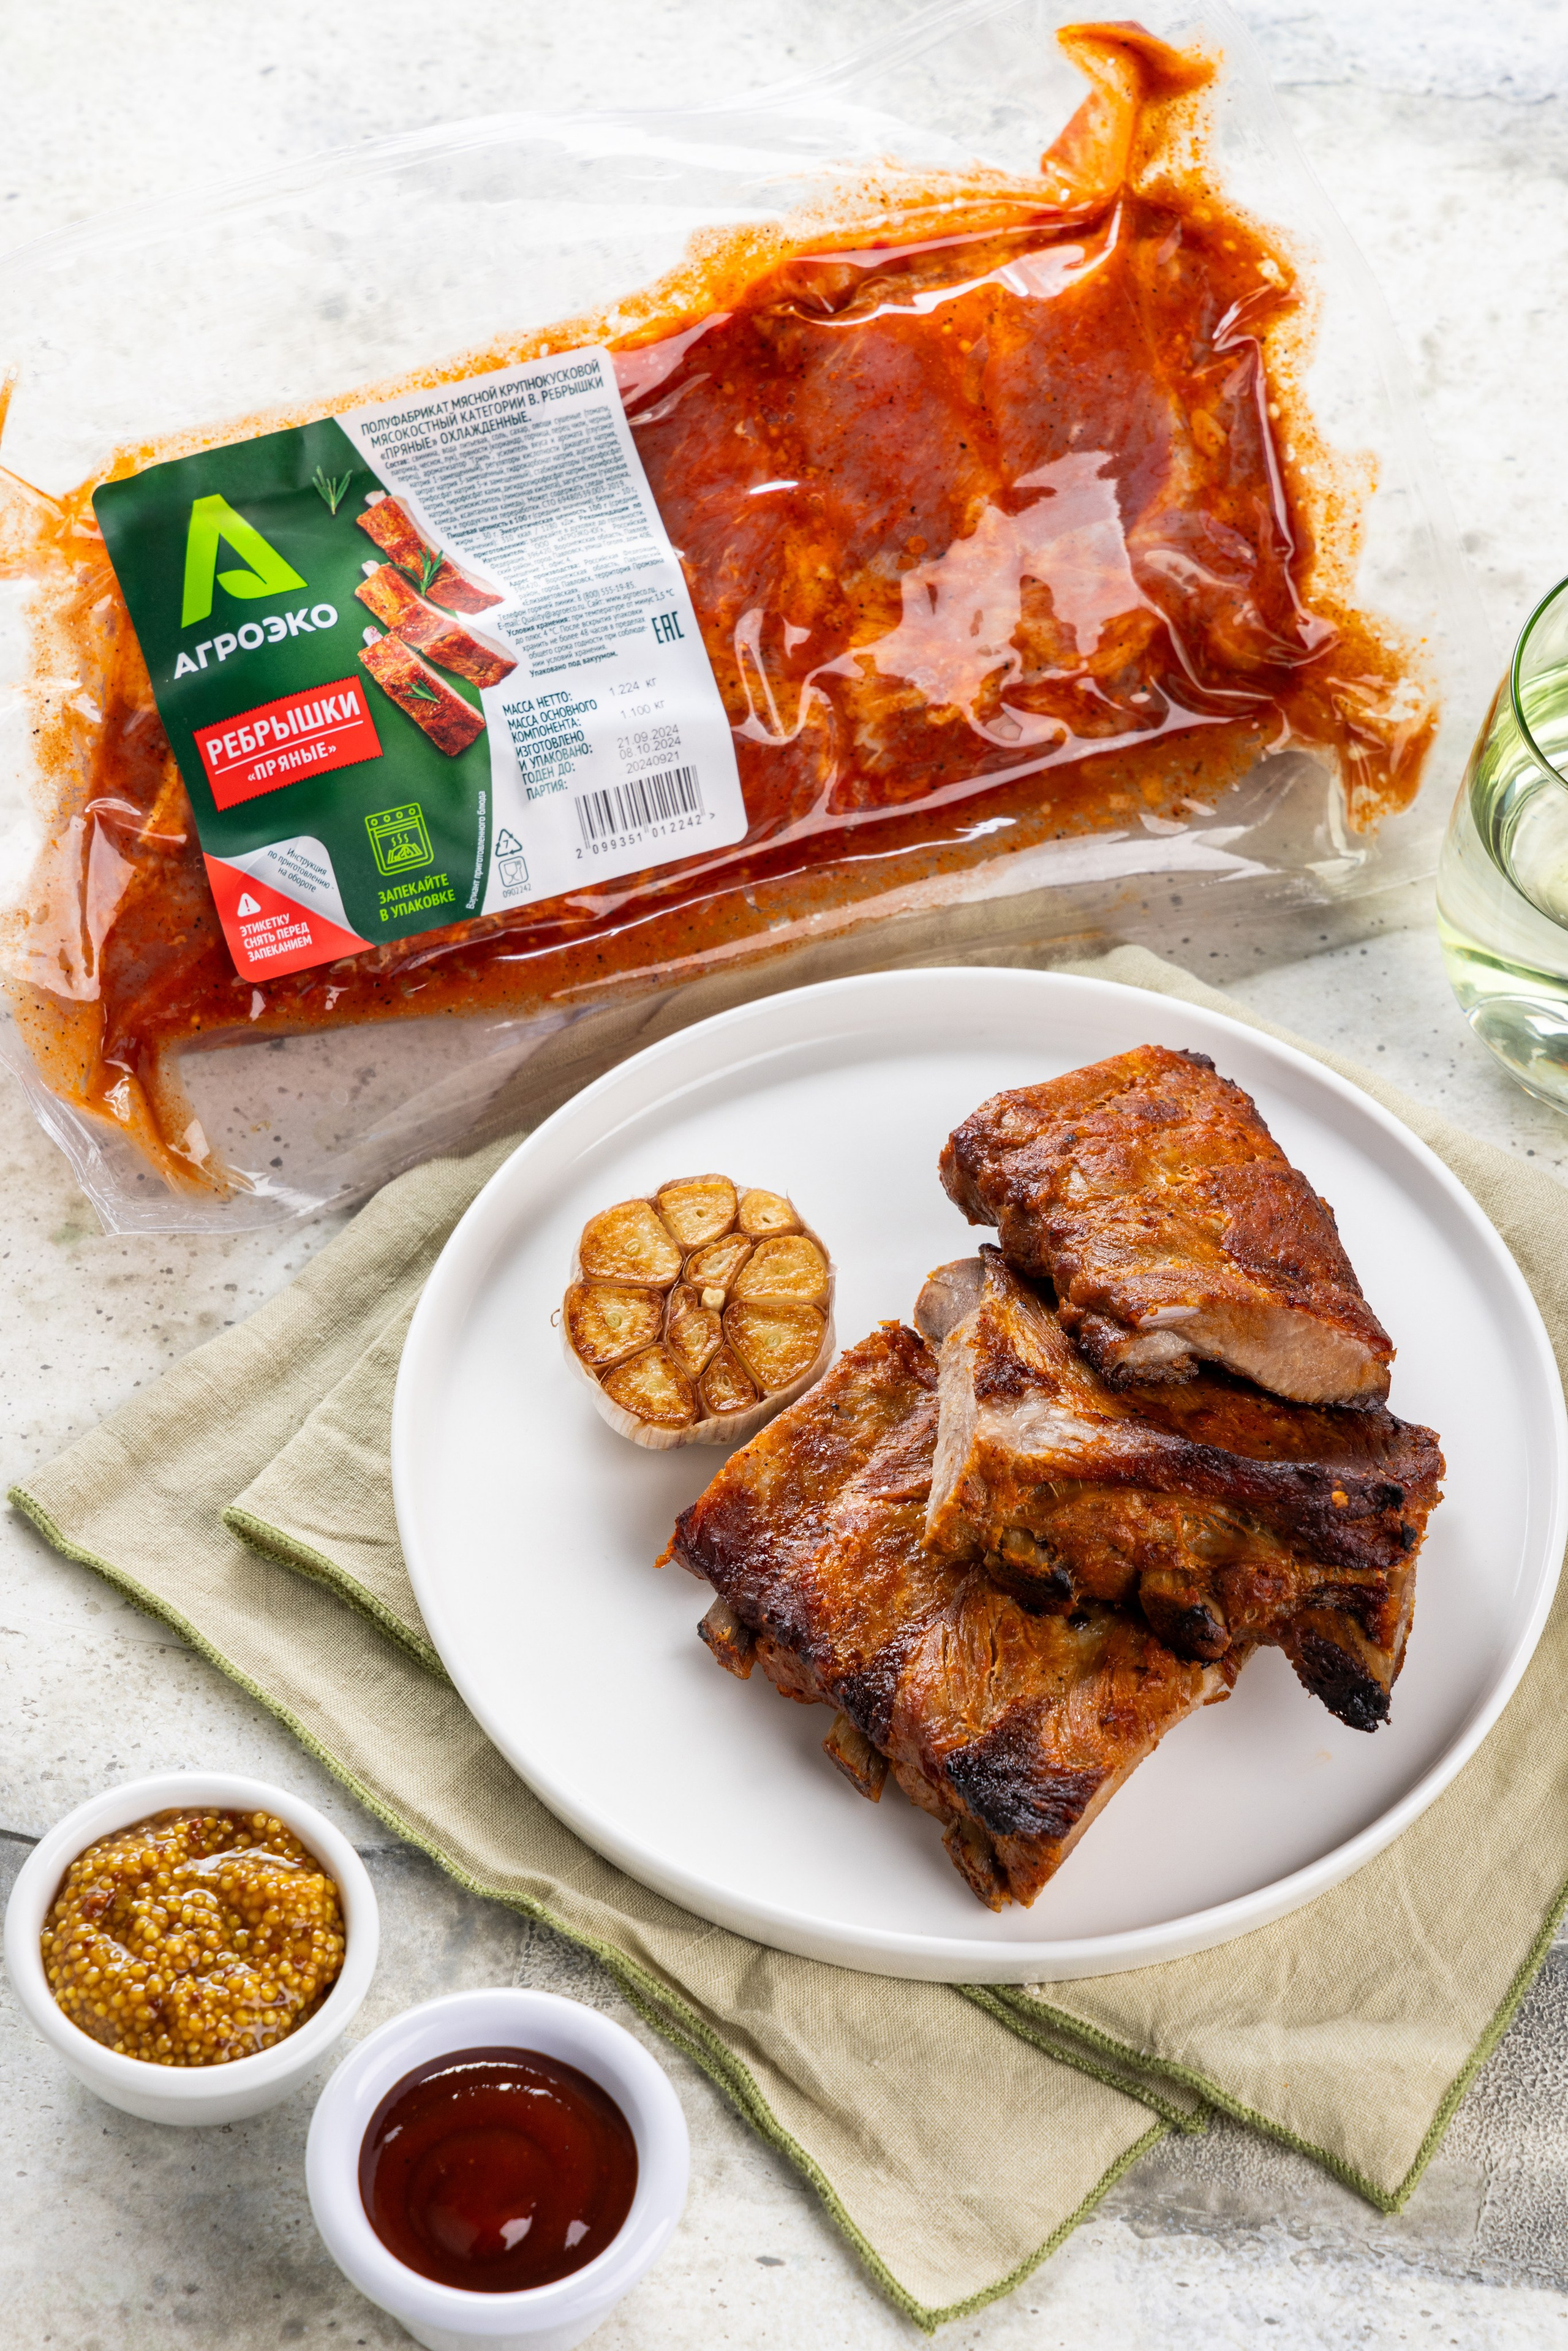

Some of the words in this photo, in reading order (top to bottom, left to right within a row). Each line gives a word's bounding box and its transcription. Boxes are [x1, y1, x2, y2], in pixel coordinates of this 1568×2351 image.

[361, 401, 451, 435] ПОЛУФАБРИКАТ
[451, 386, 497, 410] МЯСНОЙ
[499, 359, 600, 397] КРУПНОКУСКОВОЙ
[371, 412, 458, 448] МЯСОКОСТНЫЙ
[459, 396, 526, 423] КАТЕГОРИИ
[527, 393, 539, 406] В.
[540, 375, 603, 402] РЕБРЫШКИ
[380, 436, 437, 459] «ПРЯНЫЕ»
[440, 410, 531, 444] ОХЛАЖДЕННЫЕ.
[174, 603, 337, 679] АГРОЭКО
[529, 662, 567, 677] Упаковано
[567, 659, 581, 668] под
[582, 650, 618, 665] вакуумом.
[609, 681, 639, 695] 1.224
[646, 677, 655, 687] кг
[502, 700, 535, 715] МАССА
[536, 691, 572, 708] НЕТТО:
[507, 714, 538, 730] МАССА
[540, 699, 597, 722] ОСНОВНОГО
[620, 704, 650, 719] 1.100
[654, 700, 664, 709] кг
[206, 690, 360, 765] РЕБРЫШКИ
[511, 717, 581, 743] КОМПОНЕНТА:
[617, 724, 679, 749] 21.09.2024
[515, 730, 584, 757] ИЗГОТОВЛЕНО
[518, 760, 527, 772] И
[529, 742, 592, 768] УПАКОВАНО:
[619, 736, 681, 760] 08.10.2024
[247, 742, 336, 780] «ПРЯНЫЕ»
[521, 766, 554, 785] ГОДЕН
[558, 761, 575, 776] ДО:
[626, 750, 679, 774] 20240921
[477, 791, 486, 815] блюда
[526, 779, 567, 801] ПАРТИЯ:
[475, 817, 486, 878] приготовленного
[576, 848, 582, 859] 2
[592, 832, 641, 854] 099351
[652, 814, 701, 837] 012242
[268, 850, 277, 859] по
[278, 856, 330, 889] приготовлению
[287, 848, 327, 875] Инструкция
[278, 867, 287, 876] на
[288, 873, 317, 892] обороте
[378, 873, 448, 904] ЗАПЕКАЙТЕ
[502, 883, 532, 898] 0902242
[379, 908, 388, 921] В
[390, 889, 455, 918] УПАКОВКЕ
[466, 880, 480, 909] Вариант
[239, 913, 288, 937] ЭТИКЕТКУ
[244, 932, 275, 948] СНЯТЬ
[276, 922, 309, 940] ПЕРЕД
[247, 935, 312, 962] ЗАПЕКАНИЕМ
